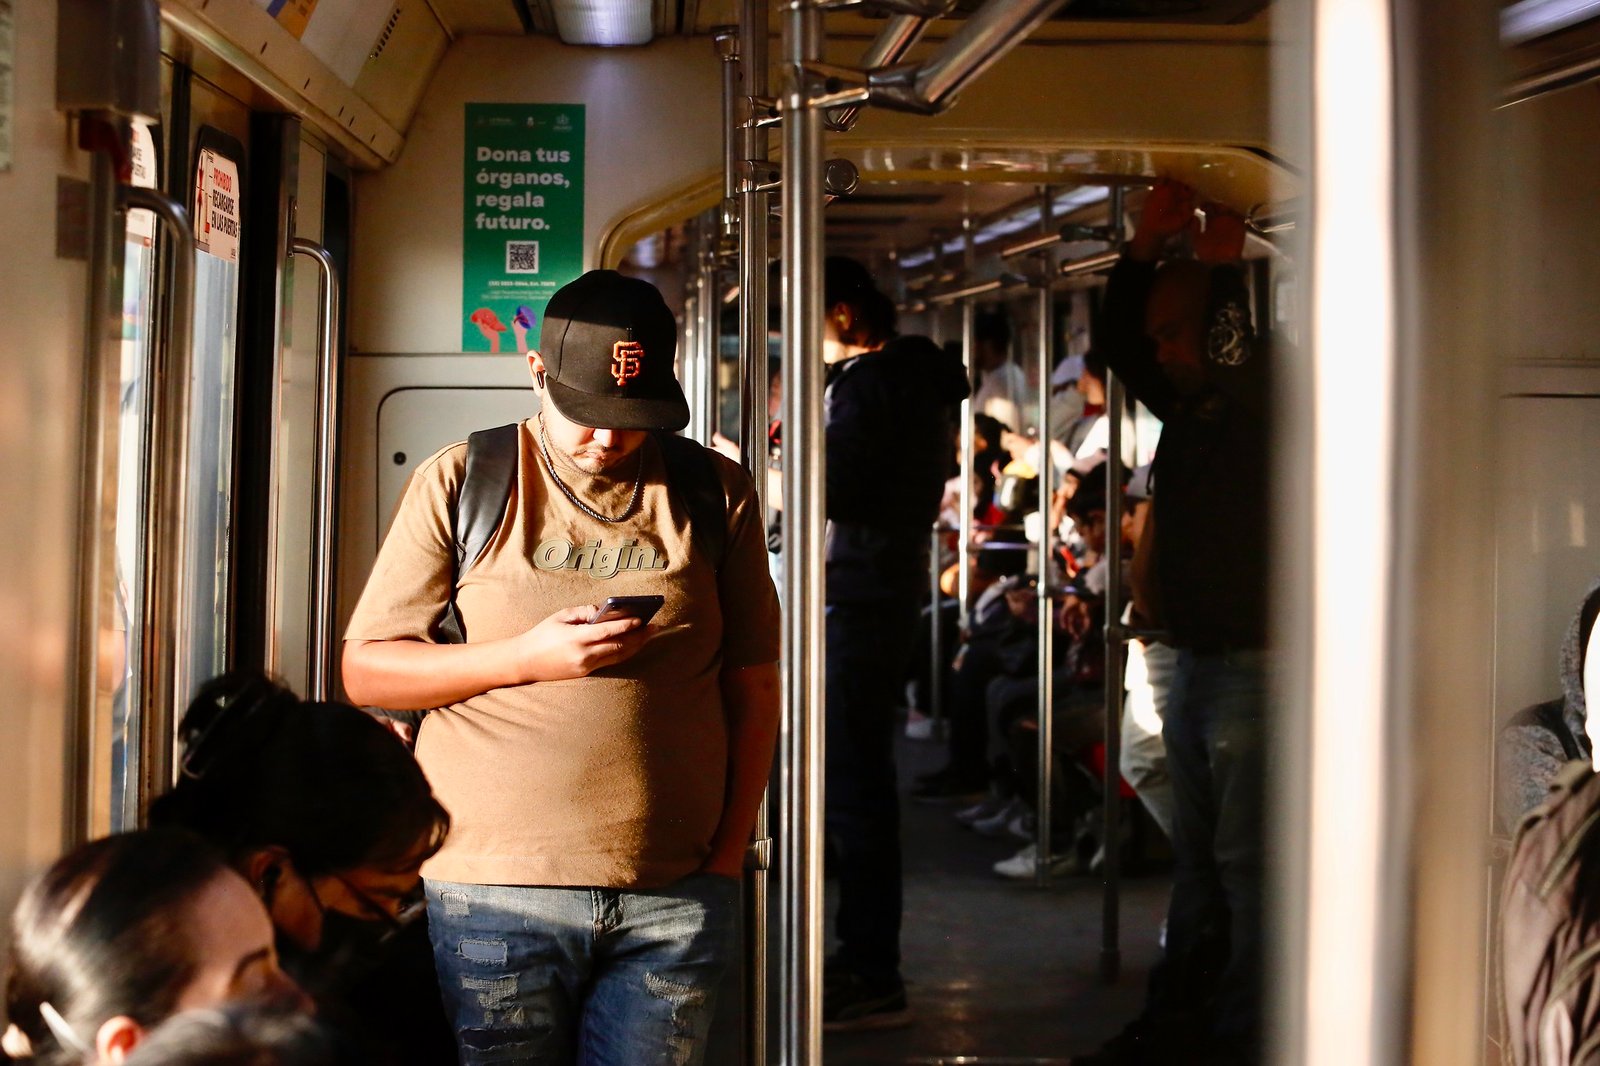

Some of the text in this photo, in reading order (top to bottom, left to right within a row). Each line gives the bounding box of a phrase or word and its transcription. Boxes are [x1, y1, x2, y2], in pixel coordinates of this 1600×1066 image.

[476, 146, 570, 163] Dona tus
[476, 168, 570, 189] órganos,
[475, 191, 544, 212] regala
[475, 212, 551, 230] futuro.
[611, 340, 645, 387] SF
